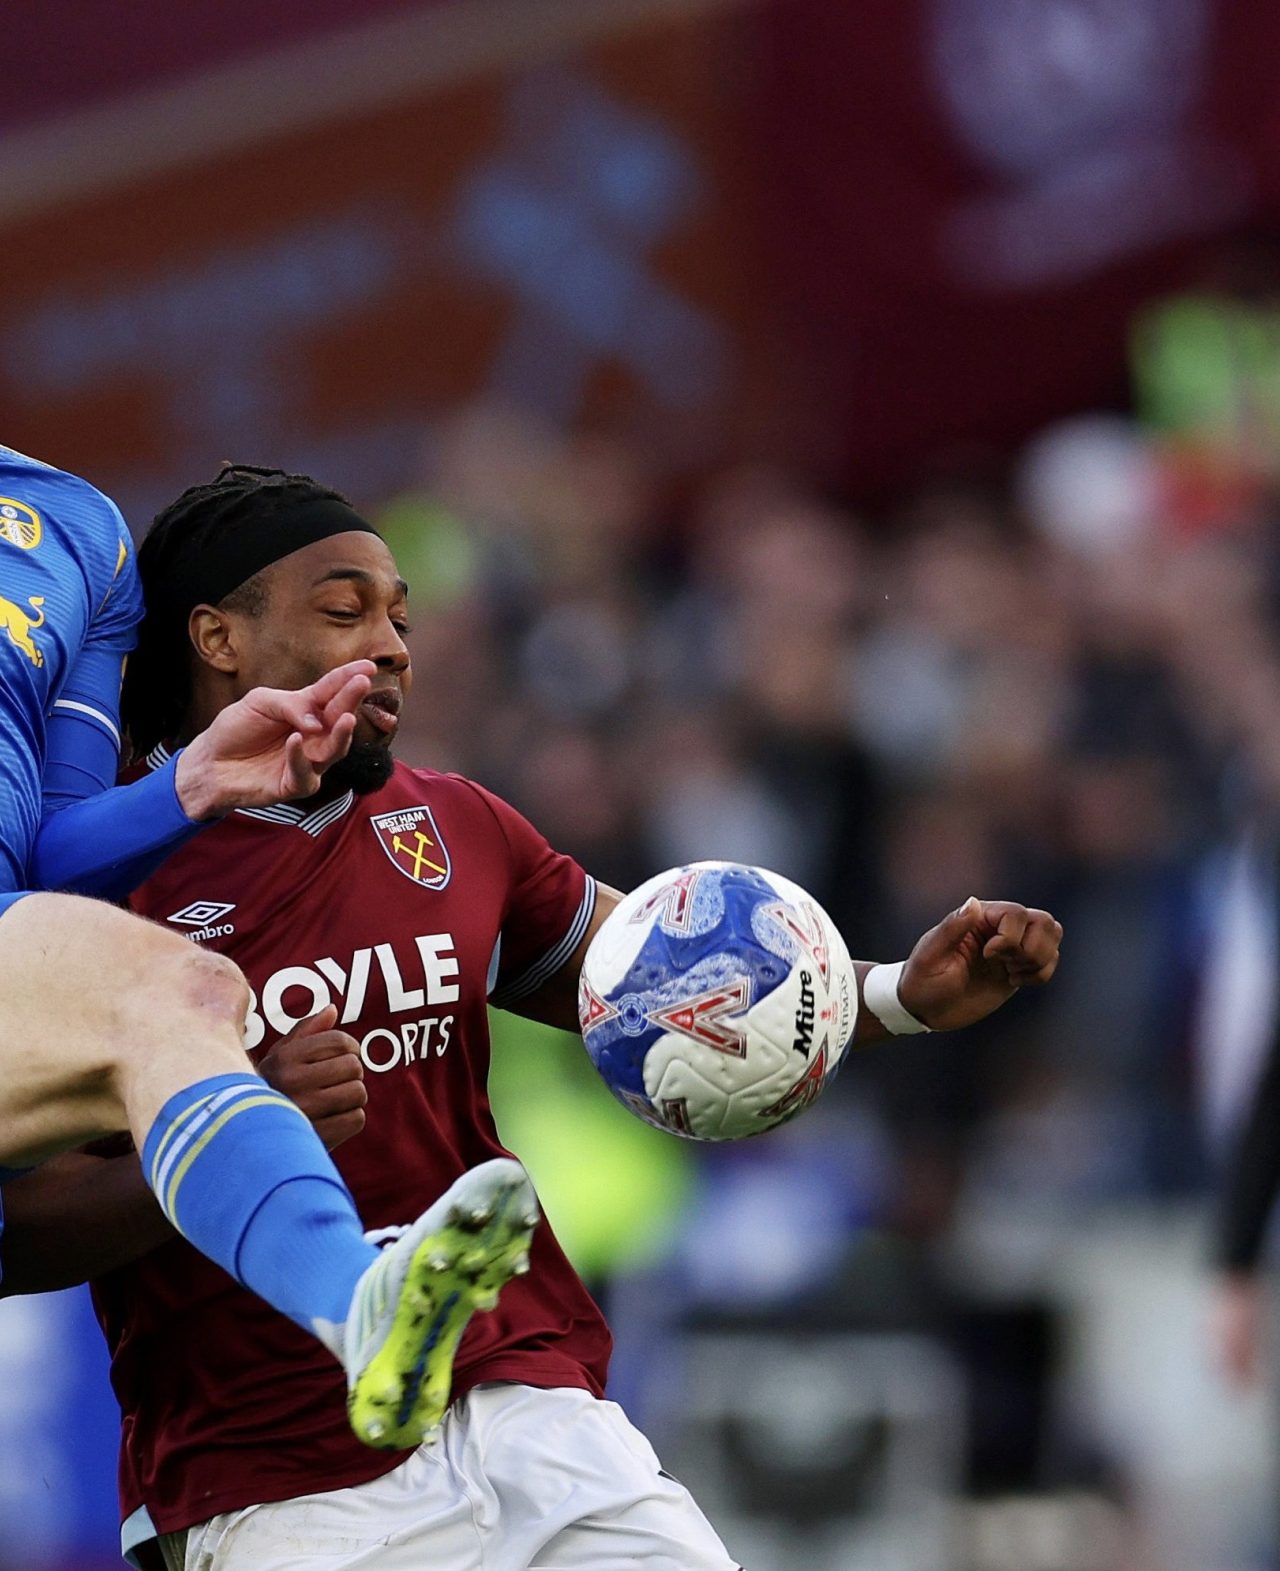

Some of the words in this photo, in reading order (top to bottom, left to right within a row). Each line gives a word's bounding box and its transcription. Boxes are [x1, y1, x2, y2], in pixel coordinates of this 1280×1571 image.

[377, 816, 399, 830] WEST
[400, 811, 425, 823] HAM
[389, 823, 417, 834] UNITED
[793, 970, 815, 1059] Mitre
[360, 1015, 454, 1073] ORTS
